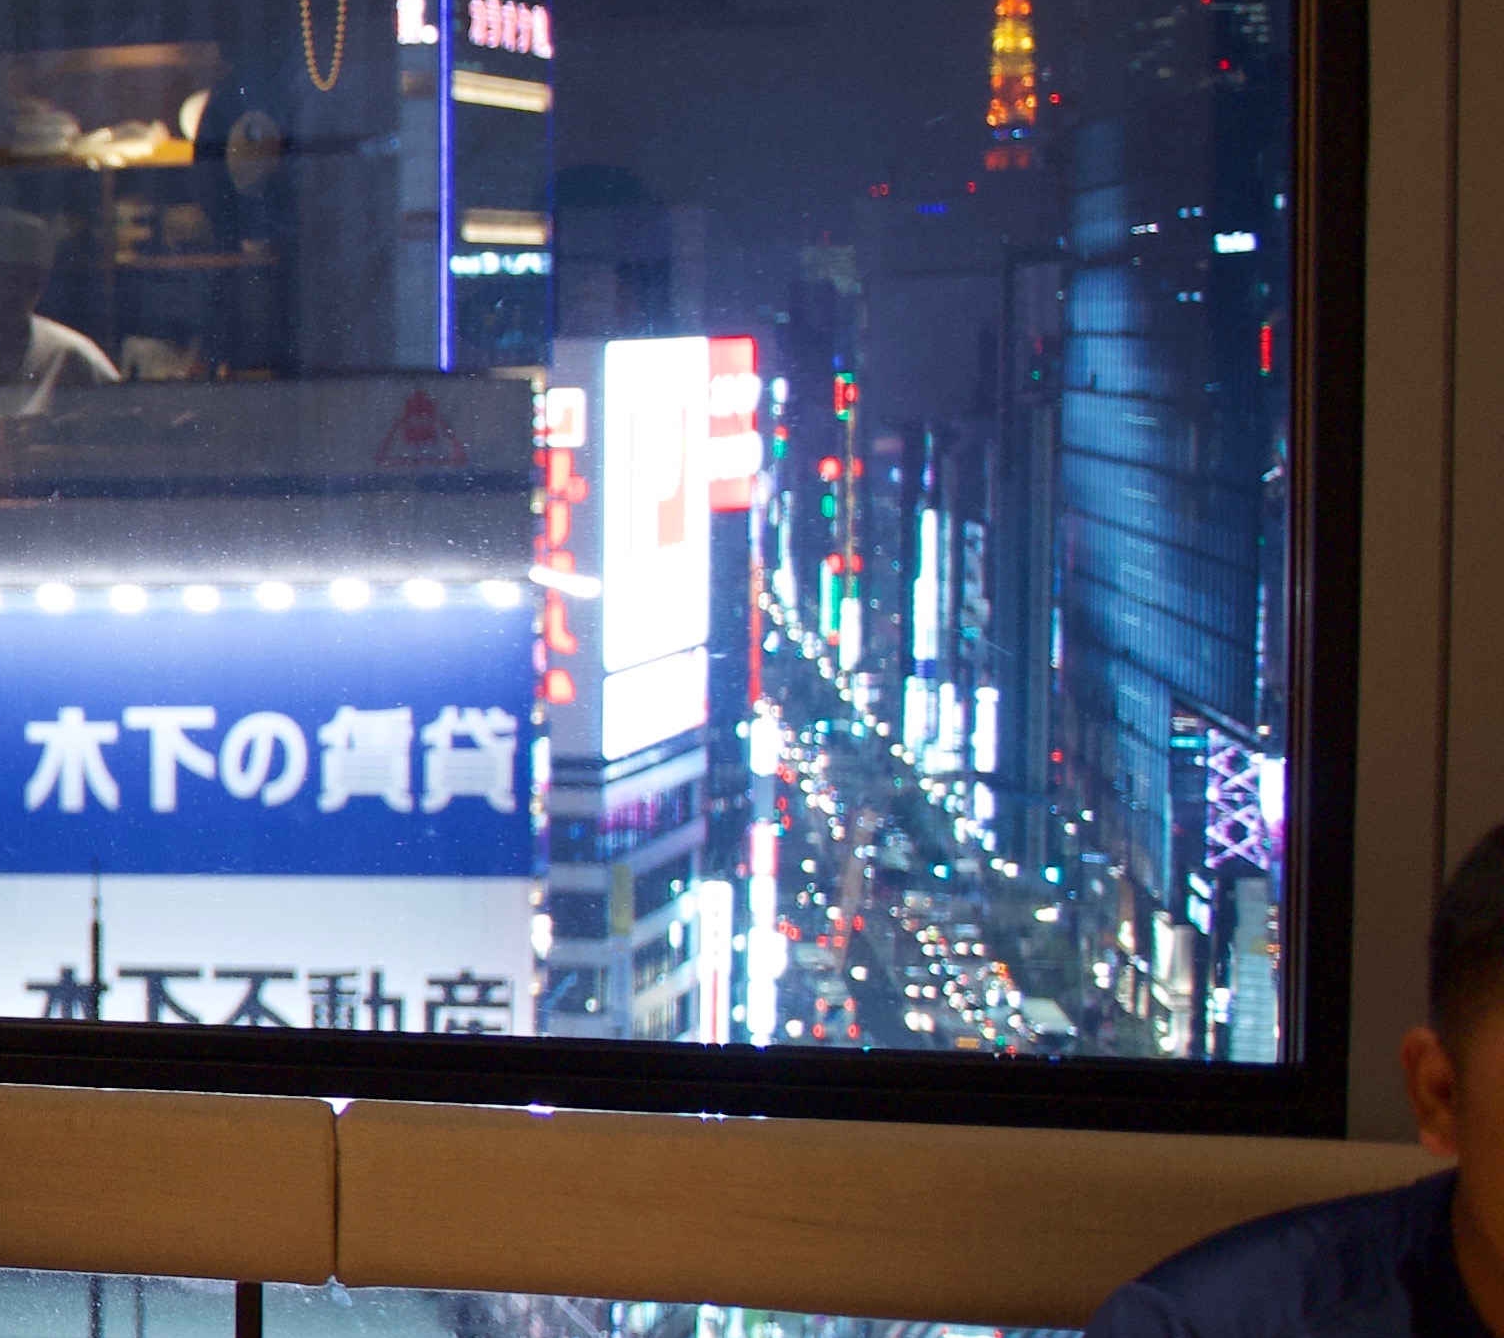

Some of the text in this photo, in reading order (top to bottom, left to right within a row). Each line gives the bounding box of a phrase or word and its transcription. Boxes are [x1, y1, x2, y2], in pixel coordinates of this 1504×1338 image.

[24, 705, 518, 814] 木下の賃貸
